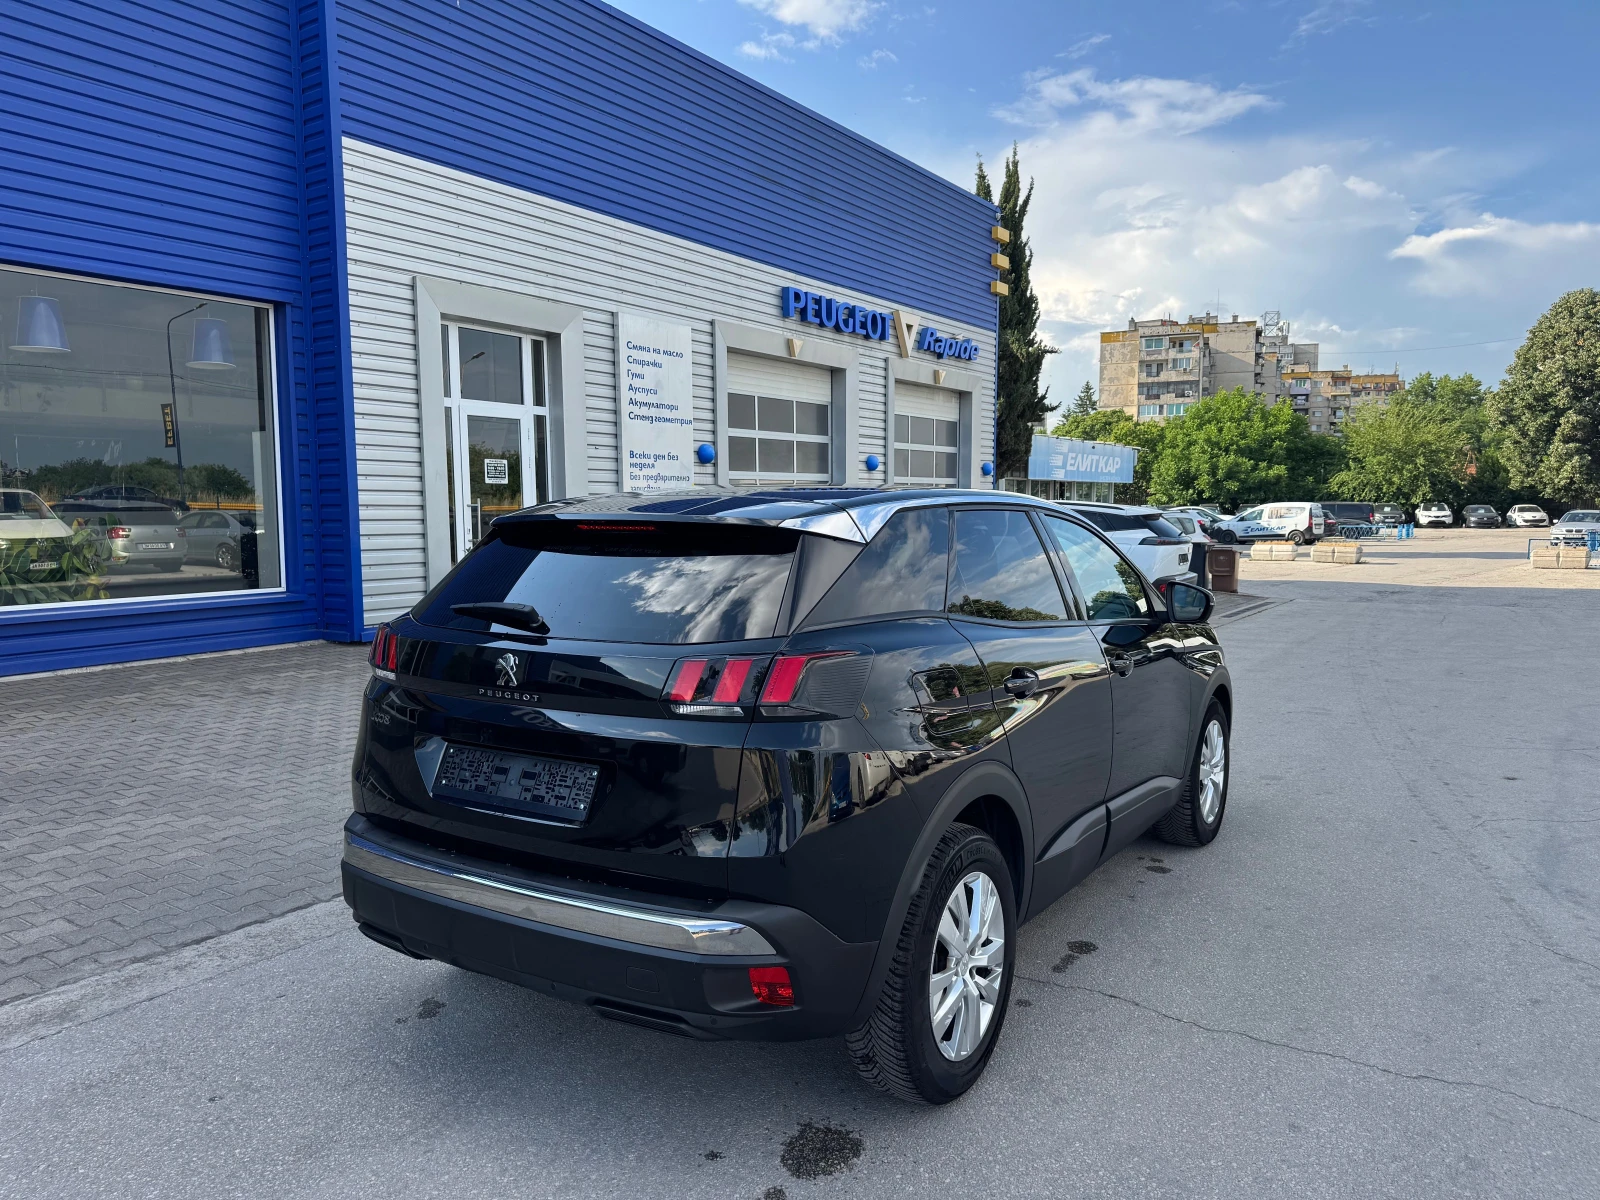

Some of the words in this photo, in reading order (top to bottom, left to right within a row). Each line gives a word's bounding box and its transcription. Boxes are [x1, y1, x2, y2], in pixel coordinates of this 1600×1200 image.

[782, 286, 894, 341] PEUGEOT
[626, 340, 651, 353] Смяна
[662, 349, 684, 359] масло
[917, 326, 980, 361] Rapide
[626, 355, 663, 369] Спирачки
[627, 369, 645, 380] Гуми
[628, 383, 658, 396] Ауспуси
[628, 397, 679, 412] Акумулатори
[628, 411, 654, 425] Стенд
[654, 415, 693, 427] геометрия
[629, 450, 652, 460] Всеки
[652, 453, 666, 462] ден
[667, 452, 679, 461] без
[629, 462, 656, 471] неделя
[629, 472, 641, 481] Без
[478, 688, 540, 702] PEUGEOT
